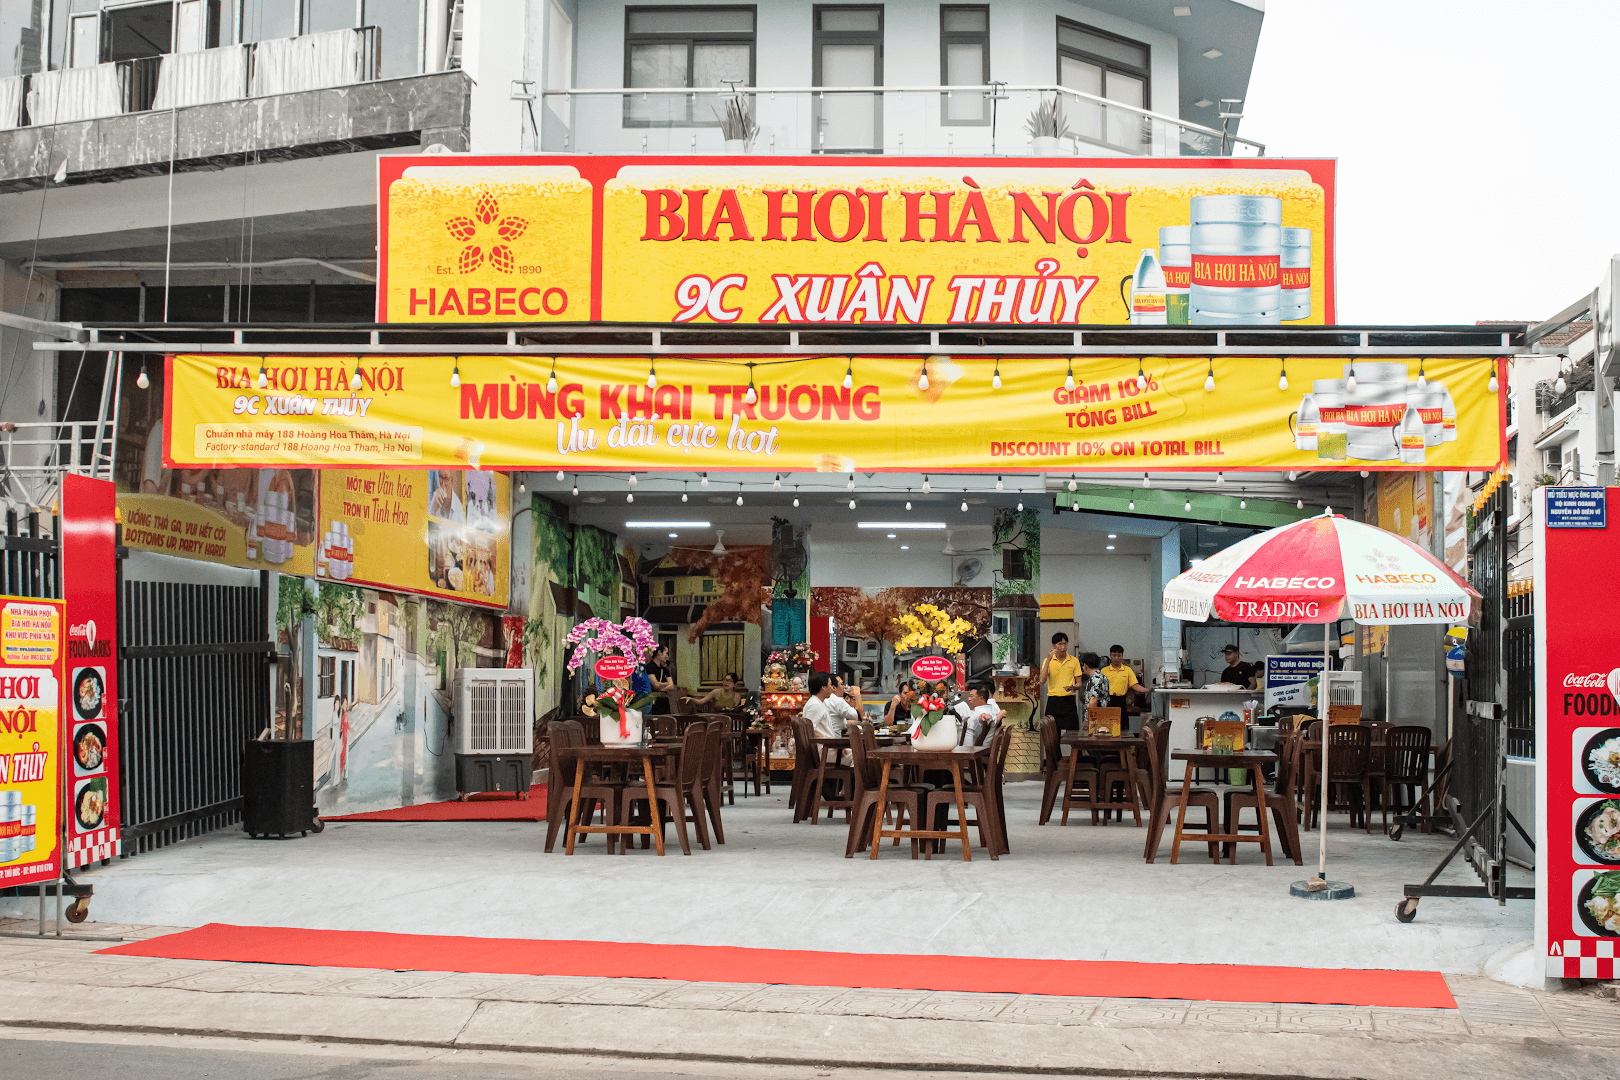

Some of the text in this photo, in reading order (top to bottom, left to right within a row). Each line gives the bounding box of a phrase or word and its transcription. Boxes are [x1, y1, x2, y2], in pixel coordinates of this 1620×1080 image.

[640, 175, 1132, 258] BIA HƠI HÀ NỘI
[436, 265, 542, 275] Est. 1890
[1194, 259, 1277, 284] BIA HƠI HÀ NỘI
[1282, 271, 1294, 286] HÀ
[409, 287, 568, 316] HABECO
[672, 258, 1099, 324] 9C XUÂN THỦY
[215, 361, 404, 396] BIA HƠI HÀ NỘI
[1053, 373, 1159, 405] GIẢM 10%
[233, 393, 373, 416] 9C XUÂN THỦY
[460, 375, 881, 421] MỪNG KHAI TRƯƠNG
[1065, 400, 1158, 428] TỔNG BILL
[1346, 412, 1360, 422] BIA
[1361, 411, 1377, 423] HƠI
[1378, 407, 1391, 422] HÀ
[205, 429, 234, 439] Chuẩn
[236, 429, 252, 439] nhà
[254, 429, 274, 441] máy
[277, 430, 294, 439] 188
[297, 429, 327, 441] Hoàng
[329, 430, 347, 439] Hoa
[379, 430, 392, 439] Hà
[394, 430, 410, 441] Nội
[607, 411, 659, 448] đãi
[666, 421, 719, 453] cực
[726, 413, 779, 456] hot
[205, 442, 413, 454] Factory-standard 188 Hoang Hoa Tham, Ha Noi
[990, 440, 1224, 457] DISCOUNT 10% ON TOTAL BILL
[392, 500, 409, 526] Hoa
[125, 527, 165, 548] BOTTOMS
[178, 537, 204, 555] PARTY
[204, 541, 227, 558] HARD!
[1234, 576, 1336, 589] HABECO
[1356, 573, 1437, 584] HABECO
[1236, 602, 1319, 617] TRADING
[1354, 598, 1465, 621] BIA HƠI HÀ NỘI
[0, 675, 40, 699] HƠI
[1563, 672, 1608, 688] Coca-Cola
[0, 704, 37, 739] NỘI
[12, 742, 48, 783] THỦY
